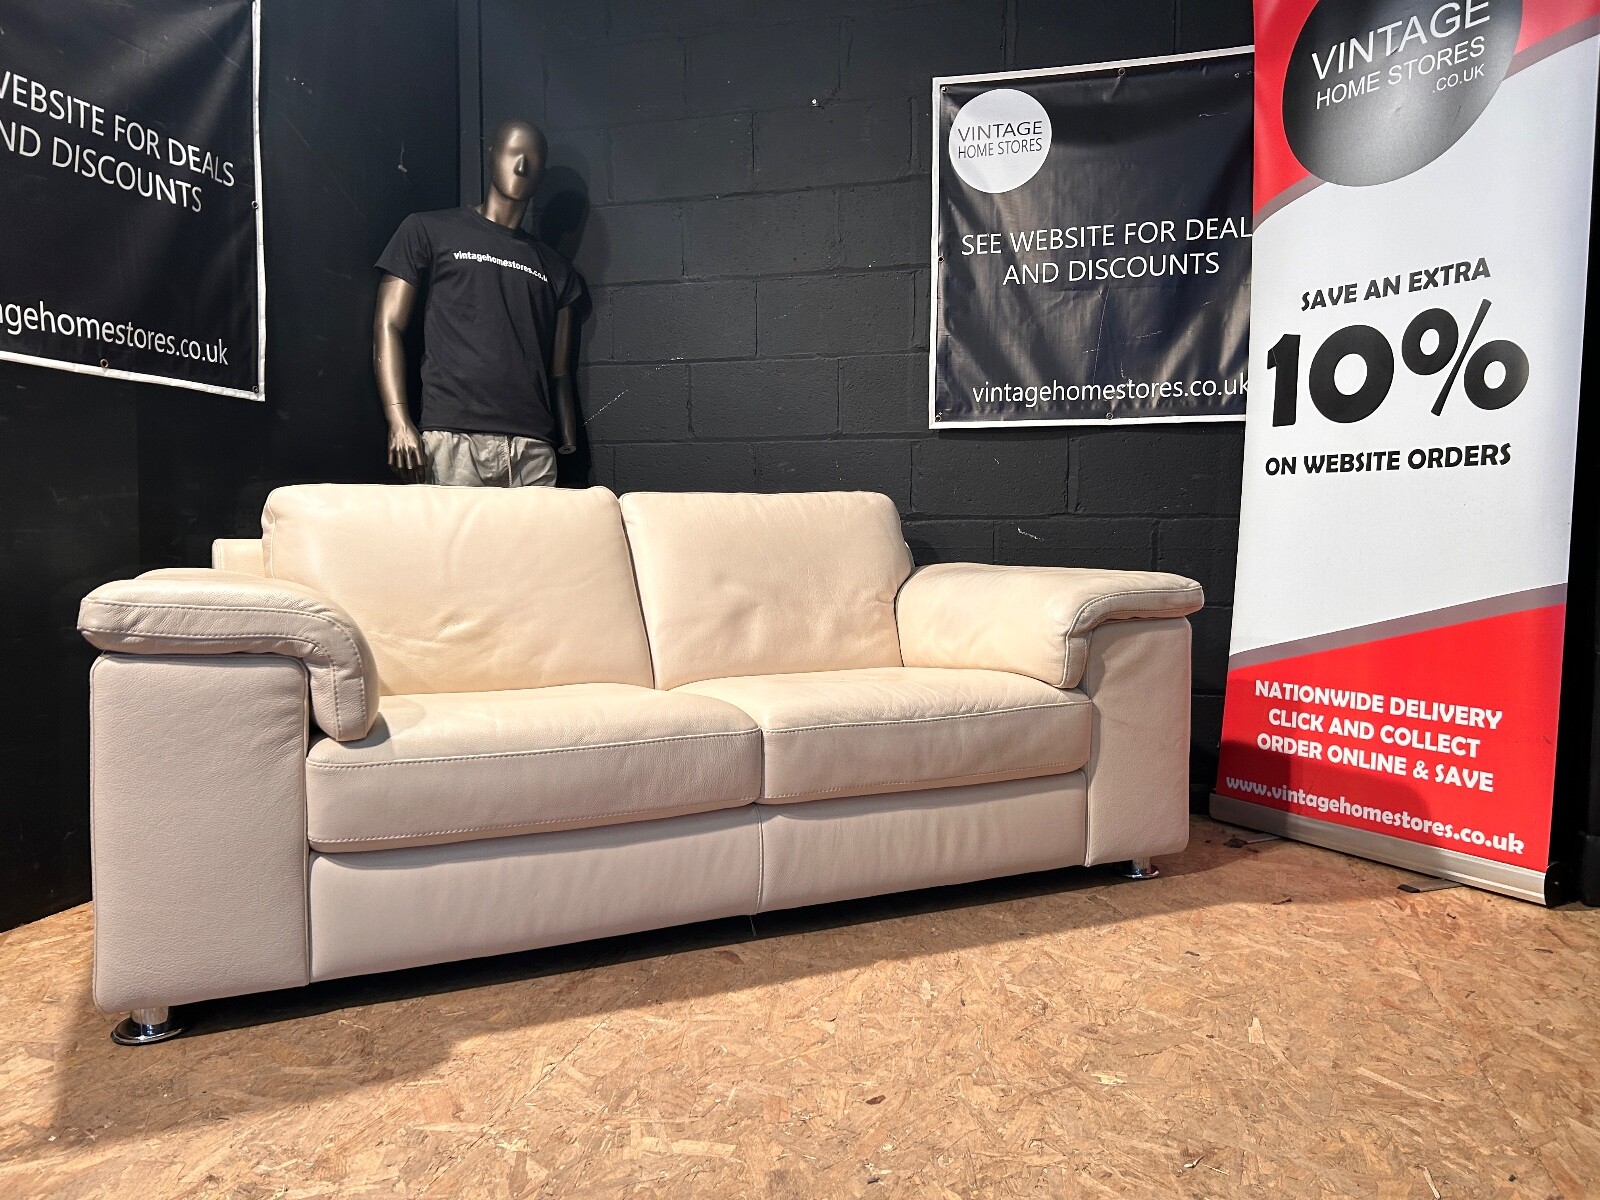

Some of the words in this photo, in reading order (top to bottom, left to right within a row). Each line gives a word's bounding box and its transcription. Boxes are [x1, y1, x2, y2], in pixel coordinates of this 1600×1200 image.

[1311, 0, 1491, 81] VINTAGE
[1316, 71, 1380, 110] HOME
[1388, 35, 1485, 86] STORES
[1432, 63, 1485, 93] .CO.UK
[114, 114, 160, 160] FOR
[168, 137, 235, 187] DEALS
[957, 120, 1043, 143] VINTAGE
[957, 143, 994, 159] HOME
[997, 137, 1043, 155] STORES
[52, 137, 202, 212] DISCOUNTS
[961, 232, 1002, 256] SEE
[1010, 224, 1115, 253] WEBSITE
[1124, 220, 1176, 244] FOR
[1002, 262, 1059, 285] AND
[1069, 252, 1220, 282] DISCOUNTS
[1301, 283, 1357, 312] SAVE
[1364, 275, 1401, 301] AN
[1408, 257, 1491, 292] EXTRA
[0, 300, 228, 365] gehomestores.co.uk
[1266, 298, 1530, 427] 10%
[972, 372, 1248, 407] vintagehomestores.co.uk
[1265, 457, 1296, 476] ON
[1304, 450, 1400, 474] WEBSITE
[1407, 442, 1511, 470] ORDERS
[1255, 680, 1384, 713] NATIONWIDE
[1390, 696, 1503, 730] DELIVERY
[1268, 708, 1324, 733] CLICK
[1329, 719, 1374, 740] AND
[1380, 725, 1480, 758] COLLECT
[1257, 733, 1322, 760] ORDER
[1327, 745, 1407, 776] ONLINE
[1412, 760, 1429, 781] &
[1434, 764, 1494, 793] SAVE
[1226, 776, 1525, 854] www.vintagehomestores.co.uk
